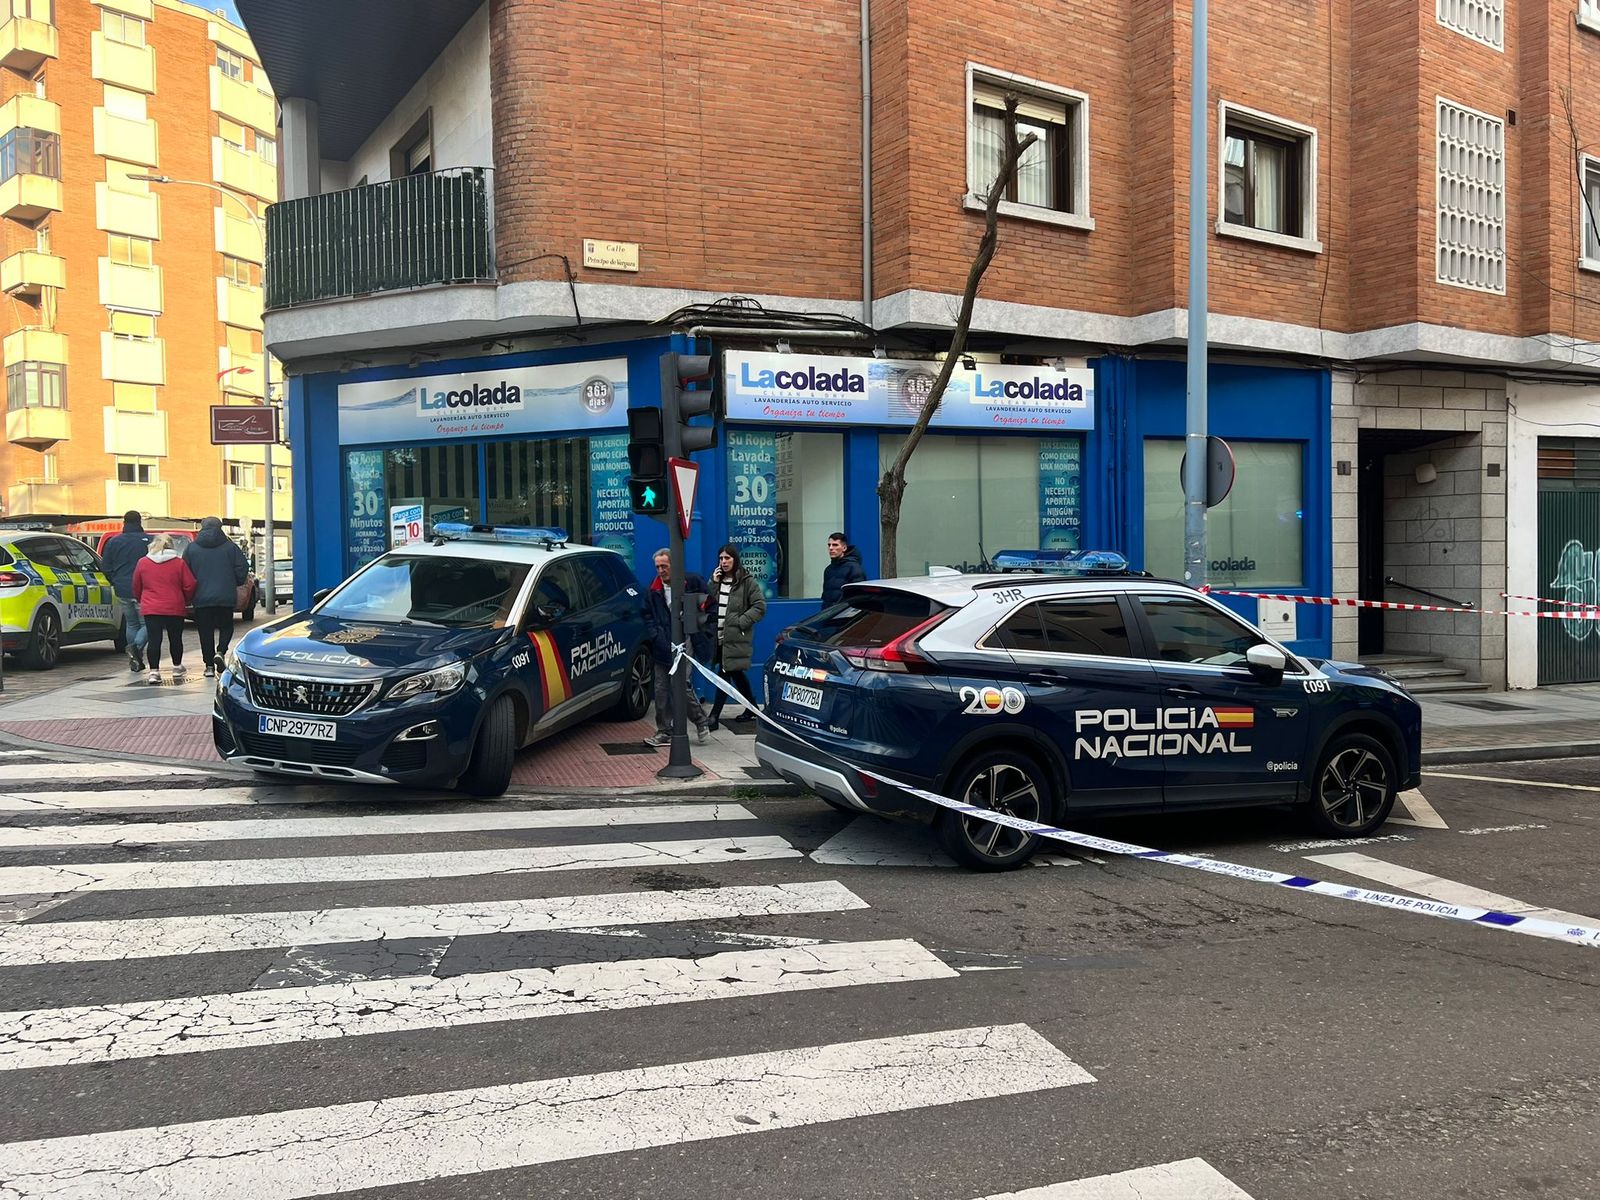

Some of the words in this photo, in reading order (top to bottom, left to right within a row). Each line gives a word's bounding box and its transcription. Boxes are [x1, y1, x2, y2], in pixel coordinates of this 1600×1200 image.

[741, 362, 865, 393] Lacolada
[586, 385, 607, 397] 365
[974, 374, 1083, 401] Lacolada
[420, 381, 521, 411] Lacolada
[483, 412, 510, 420] SERVICIO
[763, 406, 803, 419] Organiza
[806, 408, 815, 417] tu
[818, 408, 846, 419] tiempo
[993, 413, 1028, 426] Organiza
[1041, 416, 1066, 426] tiempo
[436, 424, 468, 435] Organiza
[480, 422, 504, 433] tiempo
[590, 440, 603, 449] TAN
[604, 438, 630, 448] SENCILL
[729, 432, 742, 445] Su
[745, 433, 773, 448] Ropa
[591, 451, 611, 460] COMO
[611, 450, 629, 459] ECHA
[731, 450, 771, 462] Lavada
[1041, 452, 1059, 460] COMO
[1059, 452, 1078, 460] ECHAR
[591, 463, 605, 472] UNA
[605, 461, 631, 471] MONED
[743, 463, 757, 475] EN
[1040, 462, 1053, 471] UNA
[1053, 462, 1080, 471] MONEDA
[607, 477, 619, 487] NO
[1055, 477, 1065, 485] NO
[596, 487, 630, 498] NECESITA
[734, 475, 768, 503] 30
[1044, 487, 1075, 496] NECESITA
[352, 490, 379, 517] 30
[597, 499, 631, 509] APORTAR
[1045, 497, 1076, 506] APORTAR
[409, 506, 421, 516] con
[599, 509, 628, 520] NINGÚN
[730, 504, 774, 516] Minutos
[1047, 505, 1073, 516] NINGÚN
[349, 517, 383, 529] Minutos
[594, 521, 634, 531] PRODUCTO
[737, 519, 766, 527] HORARIO
[1042, 517, 1078, 526] PRODUCTO
[407, 522, 419, 538] 10
[747, 527, 757, 535] DE
[992, 588, 1026, 605] 3HR
[570, 641, 626, 680] NACIONAL
[786, 684, 820, 707] CNP8077BA
[959, 685, 1026, 715] 200
[776, 711, 797, 722] ECLIPSE
[799, 719, 819, 729] CROSS
[1074, 706, 1219, 733] POLICÍA
[266, 718, 334, 739] CNP2977RZ
[1074, 732, 1252, 760] NACIONAL
[1266, 761, 1298, 772] @policia
[1242, 867, 1274, 878] POLICIA
[1363, 891, 1395, 905] LINEA
[1396, 897, 1412, 907] DE
[1412, 901, 1459, 917] POLICIA
